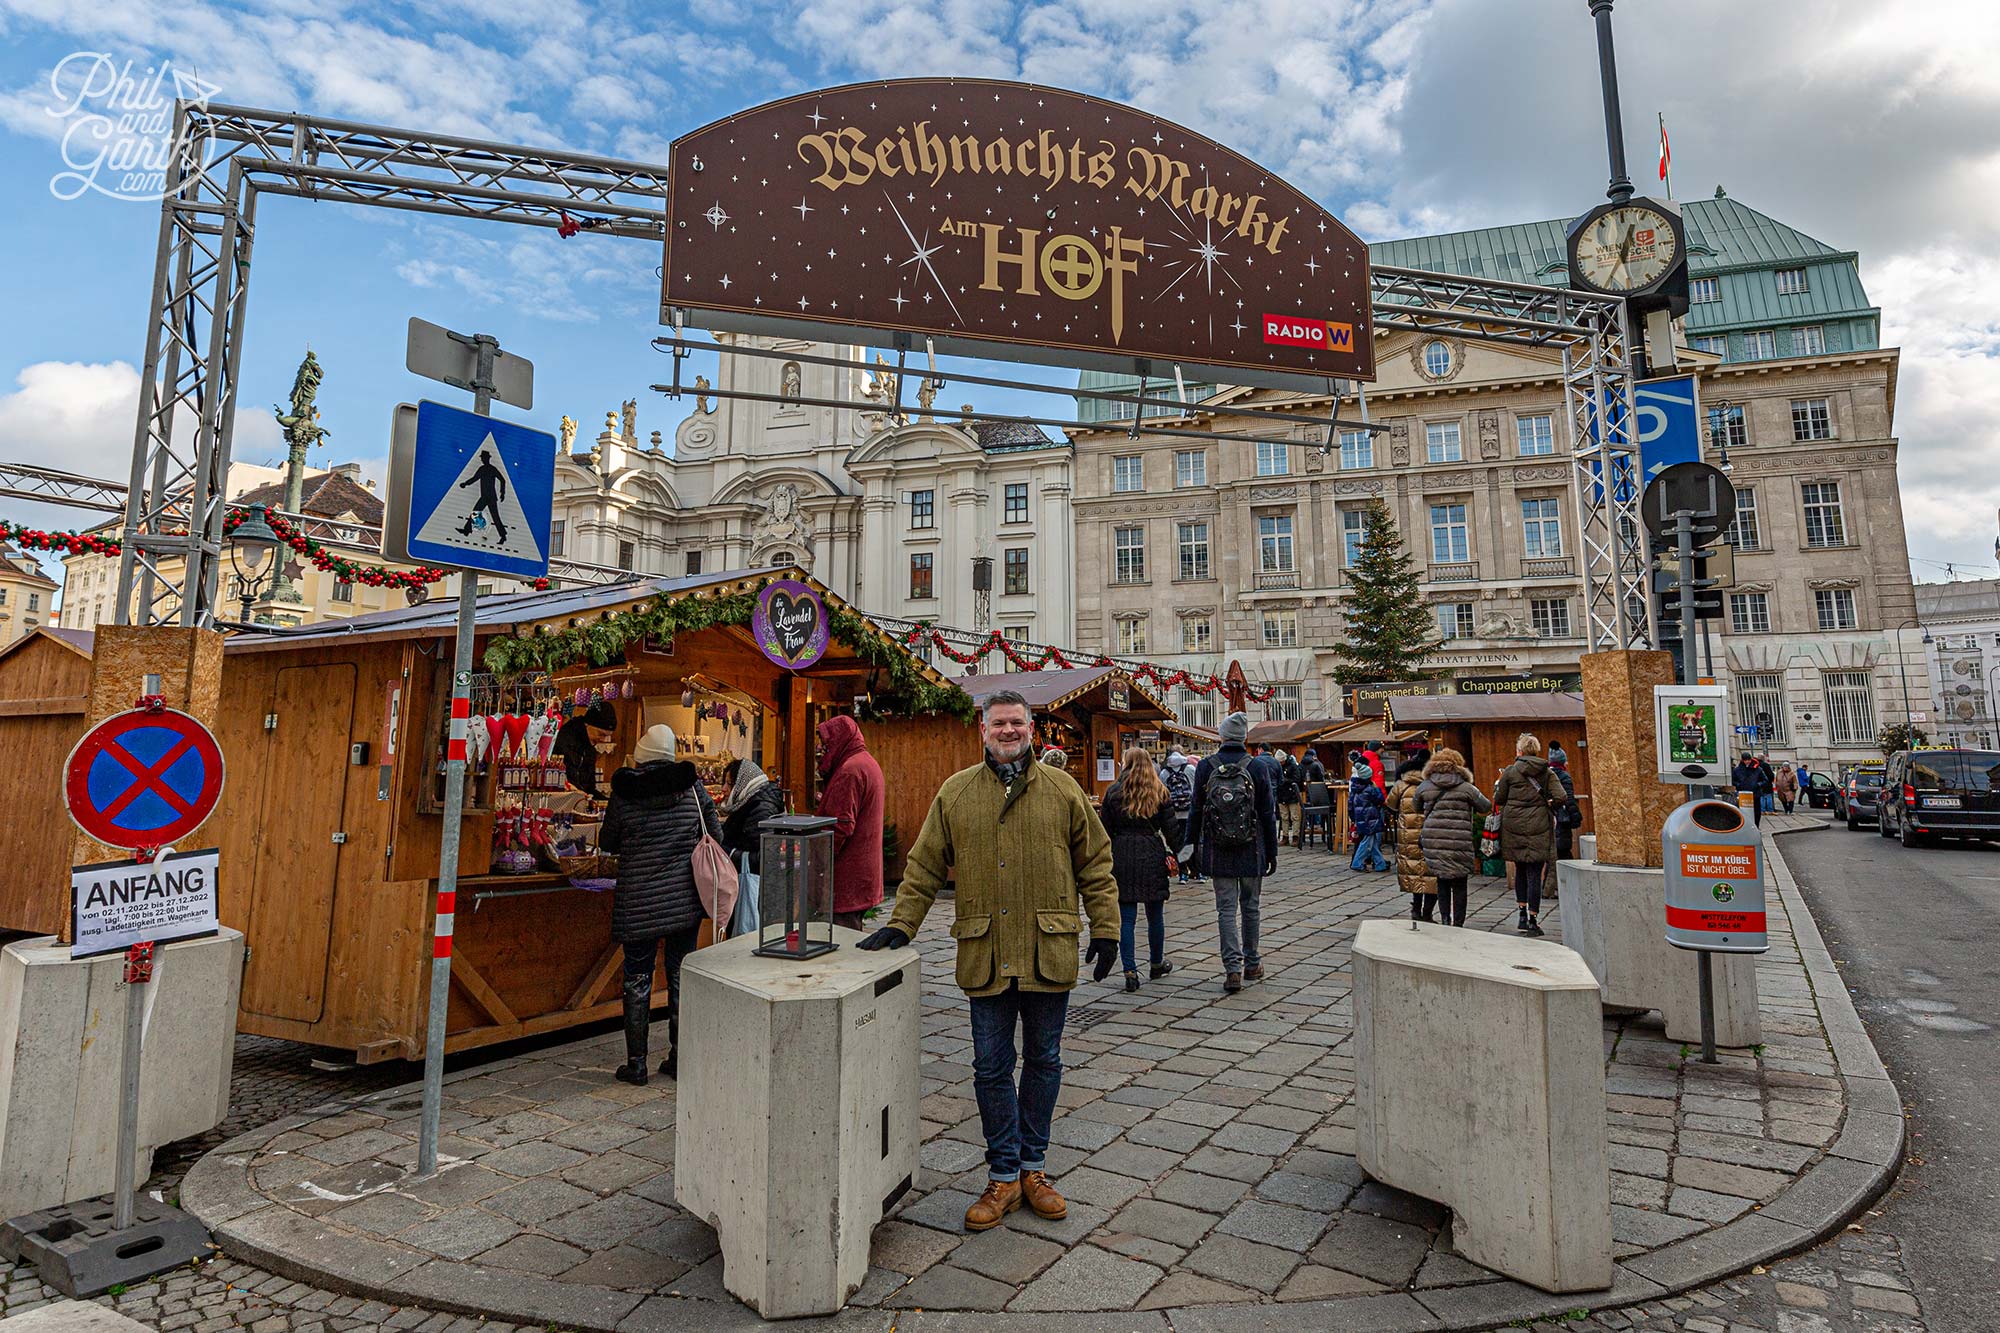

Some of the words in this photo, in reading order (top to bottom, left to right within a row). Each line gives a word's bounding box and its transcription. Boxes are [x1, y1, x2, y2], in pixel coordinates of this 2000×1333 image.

[797, 120, 1116, 191] Weihnachts
[1124, 147, 1290, 255] Markt
[1267, 321, 1324, 341] RADIO
[1328, 327, 1351, 346] W
[775, 607, 812, 631] Lavendel
[784, 629, 804, 650] Frau
[1436, 656, 1472, 664] HYATT
[1475, 654, 1519, 662] VIENNA
[1360, 687, 1411, 700] Champagner
[1413, 685, 1429, 695] Bar
[1462, 680, 1538, 692] Champagner
[1542, 678, 1563, 689] Bar
[1686, 854, 1709, 864] MIST
[1711, 855, 1722, 864] IM
[1725, 854, 1751, 865] KÜBEL
[1687, 864, 1699, 873] IST
[1702, 865, 1726, 874] NICHT
[1728, 865, 1749, 875] ÜBEL.
[84, 867, 204, 909] ANFANG
[82, 912, 99, 920] von
[102, 903, 149, 916] 02.11.2022
[151, 901, 164, 909] bis
[166, 893, 209, 906] 27.12.2022
[105, 916, 122, 925] tägl.
[124, 913, 140, 921] 7:00
[156, 907, 175, 915] 22:00
[82, 927, 103, 936] ausg.
[105, 917, 155, 932] Ladetätigkeit
[168, 909, 208, 922] Wagenkarte
